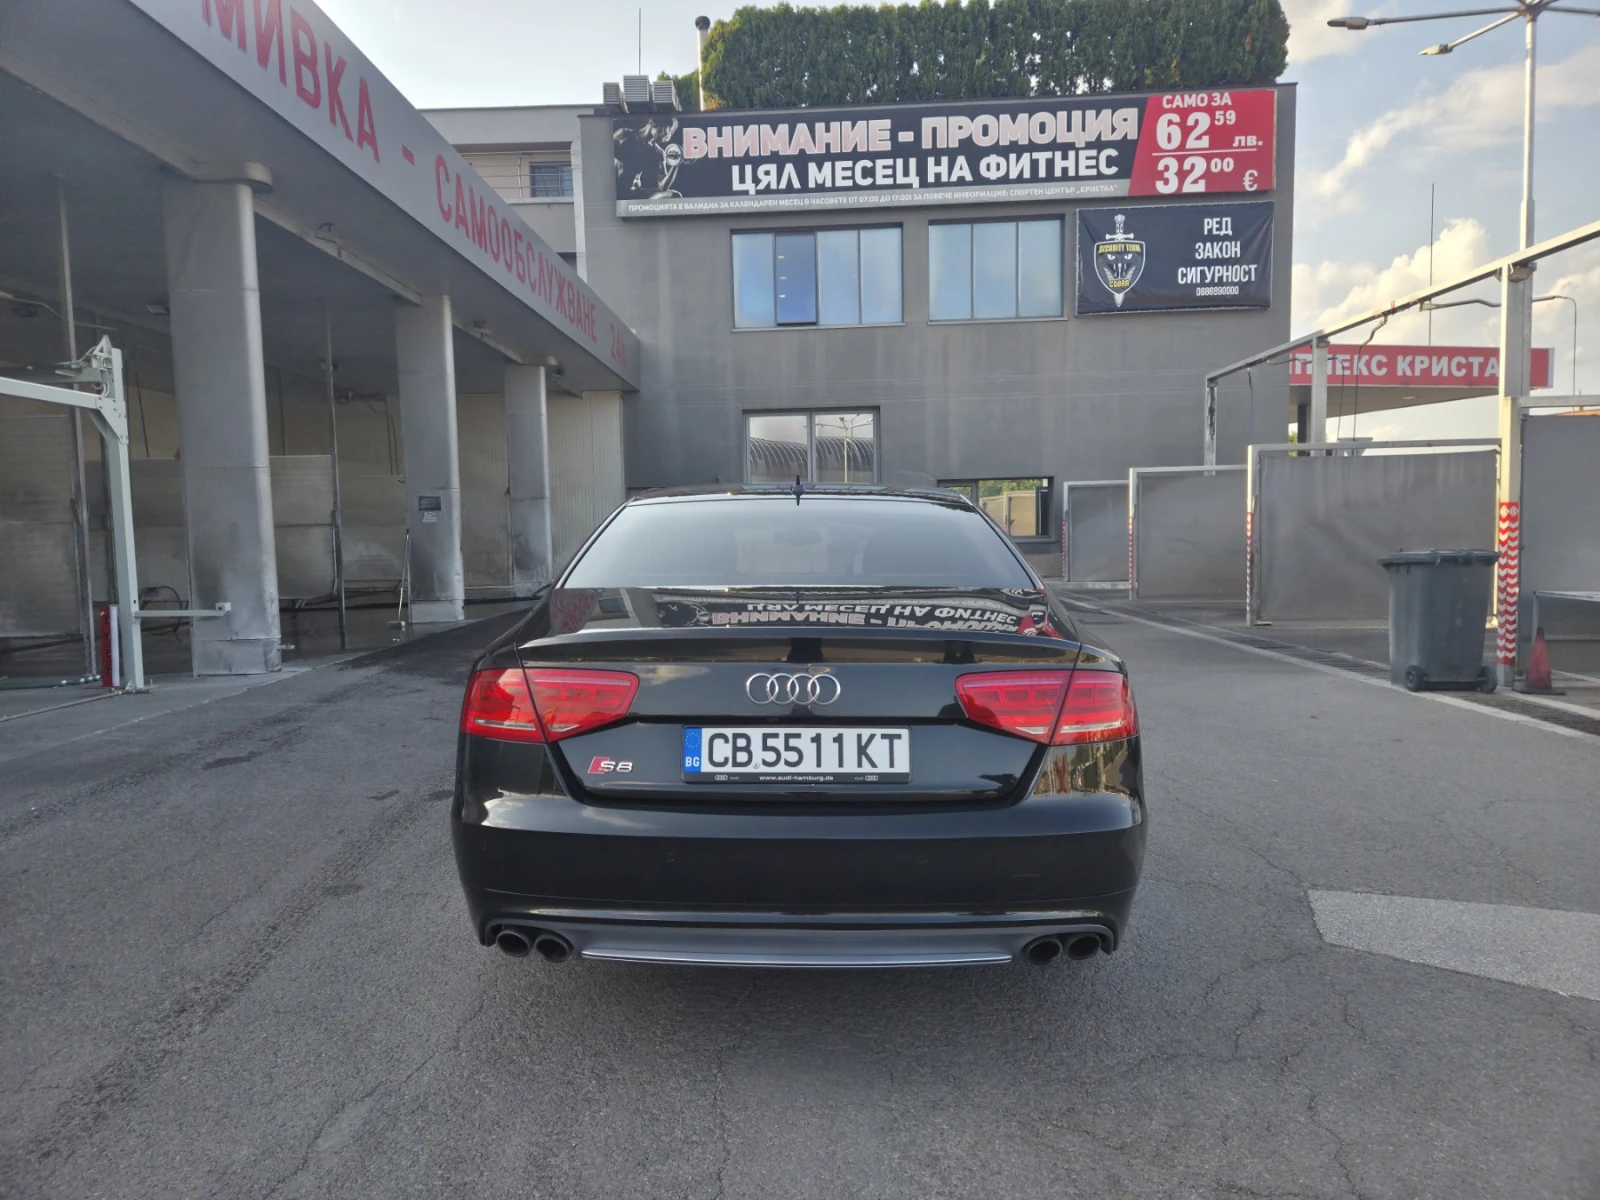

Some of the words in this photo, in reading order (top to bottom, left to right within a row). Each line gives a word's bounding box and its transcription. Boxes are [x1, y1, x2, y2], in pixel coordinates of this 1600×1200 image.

[1162, 93, 1208, 109] САМО
[1211, 92, 1232, 106] ЗА
[683, 119, 891, 159] ВНИМАНИЕ
[922, 107, 1138, 149] ПРОМОЦИЯ
[1156, 111, 1211, 150] 62
[1214, 110, 1236, 126] 59
[1232, 135, 1263, 147] лв.
[732, 163, 801, 195] ЦЯЛ
[808, 157, 919, 189] МЕСЕЦ
[927, 155, 973, 183] НА
[979, 148, 1119, 181] ФИТНЕС
[1155, 156, 1207, 194] 32
[1210, 157, 1234, 172] 00
[1243, 170, 1258, 191] €
[684, 202, 718, 211] ВАЛИДНА
[730, 199, 778, 208] КАЛЕНДАРЕН
[780, 198, 803, 207] МЕСЕЦ
[810, 197, 847, 205] ЧАСОВЕТЕ
[880, 195, 891, 203] ДО
[1010, 188, 1044, 196] СПОРТЕН
[1045, 187, 1075, 195] ЦЕНТЪР
[1203, 217, 1232, 236] РЕД
[435, 154, 597, 343] САМООБСЛУЖВАНЕ
[1195, 241, 1240, 260] ЗАКОН
[1178, 264, 1257, 284] СИГУРНОСТ
[1397, 355, 1500, 378] КРИСТА
[600, 761, 633, 773] S8
[685, 756, 700, 767] BG
